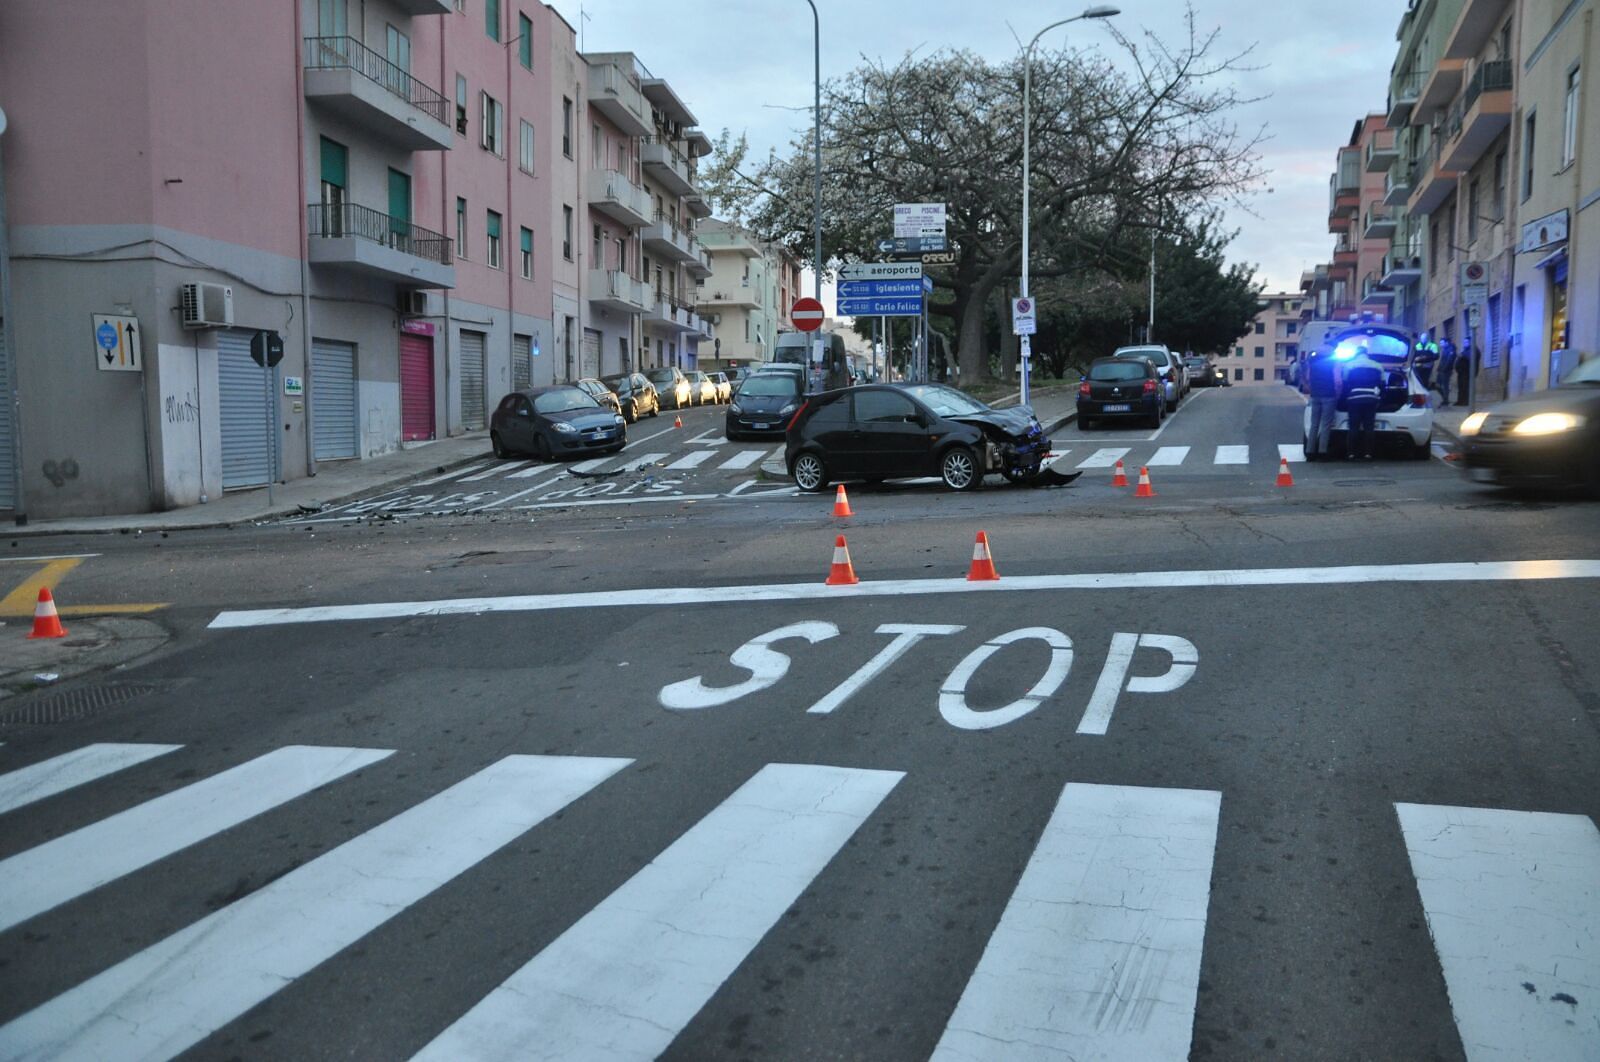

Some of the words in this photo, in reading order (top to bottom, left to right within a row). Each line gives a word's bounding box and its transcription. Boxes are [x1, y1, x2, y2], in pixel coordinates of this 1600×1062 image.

[922, 253, 954, 263] ORRU
[871, 265, 920, 276] aeroporto
[875, 303, 896, 311] Carlo
[897, 302, 920, 310] Felice
[537, 479, 683, 501] STOP
[657, 620, 1200, 736] STOP
